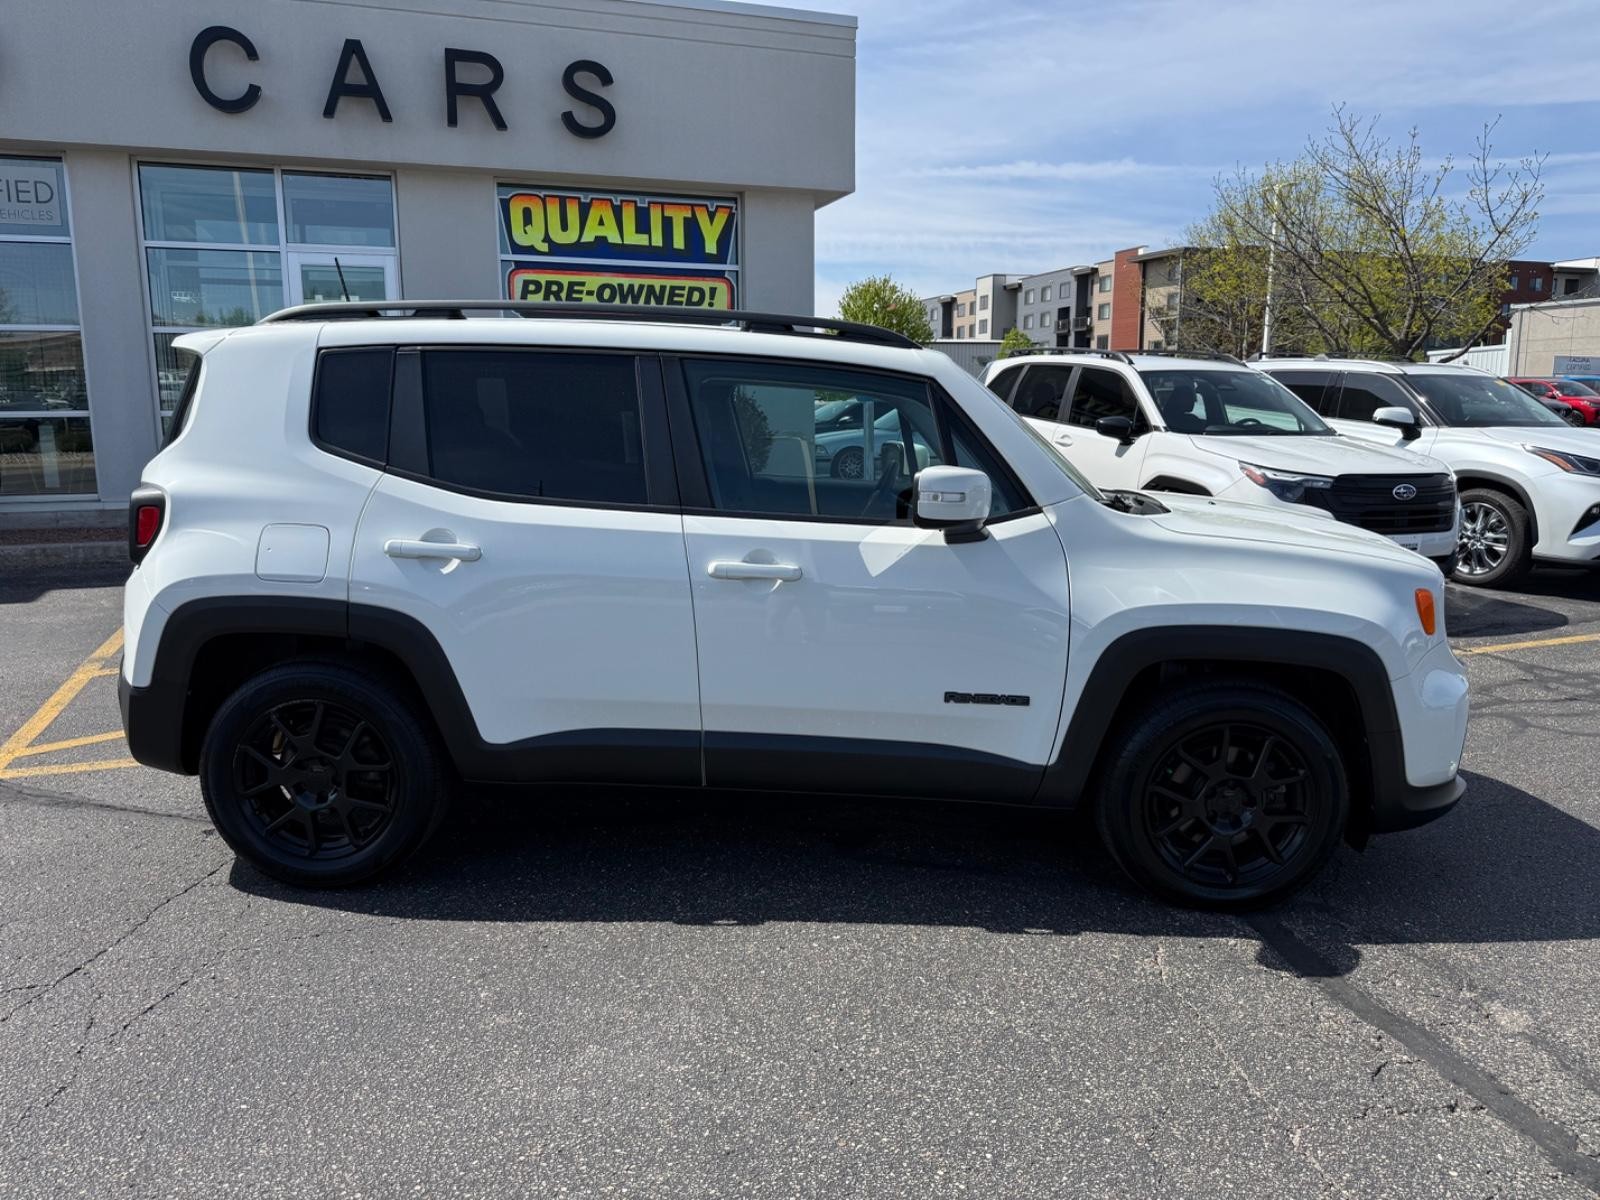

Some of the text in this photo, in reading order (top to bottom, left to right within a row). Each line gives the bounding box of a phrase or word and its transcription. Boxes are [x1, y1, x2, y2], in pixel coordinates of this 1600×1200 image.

[189, 25, 617, 139] CARS
[0, 179, 54, 203] IED
[509, 194, 731, 255] QUALITY
[520, 279, 717, 307] PRE-OWNED!
[944, 691, 1030, 706] RENEGADE
